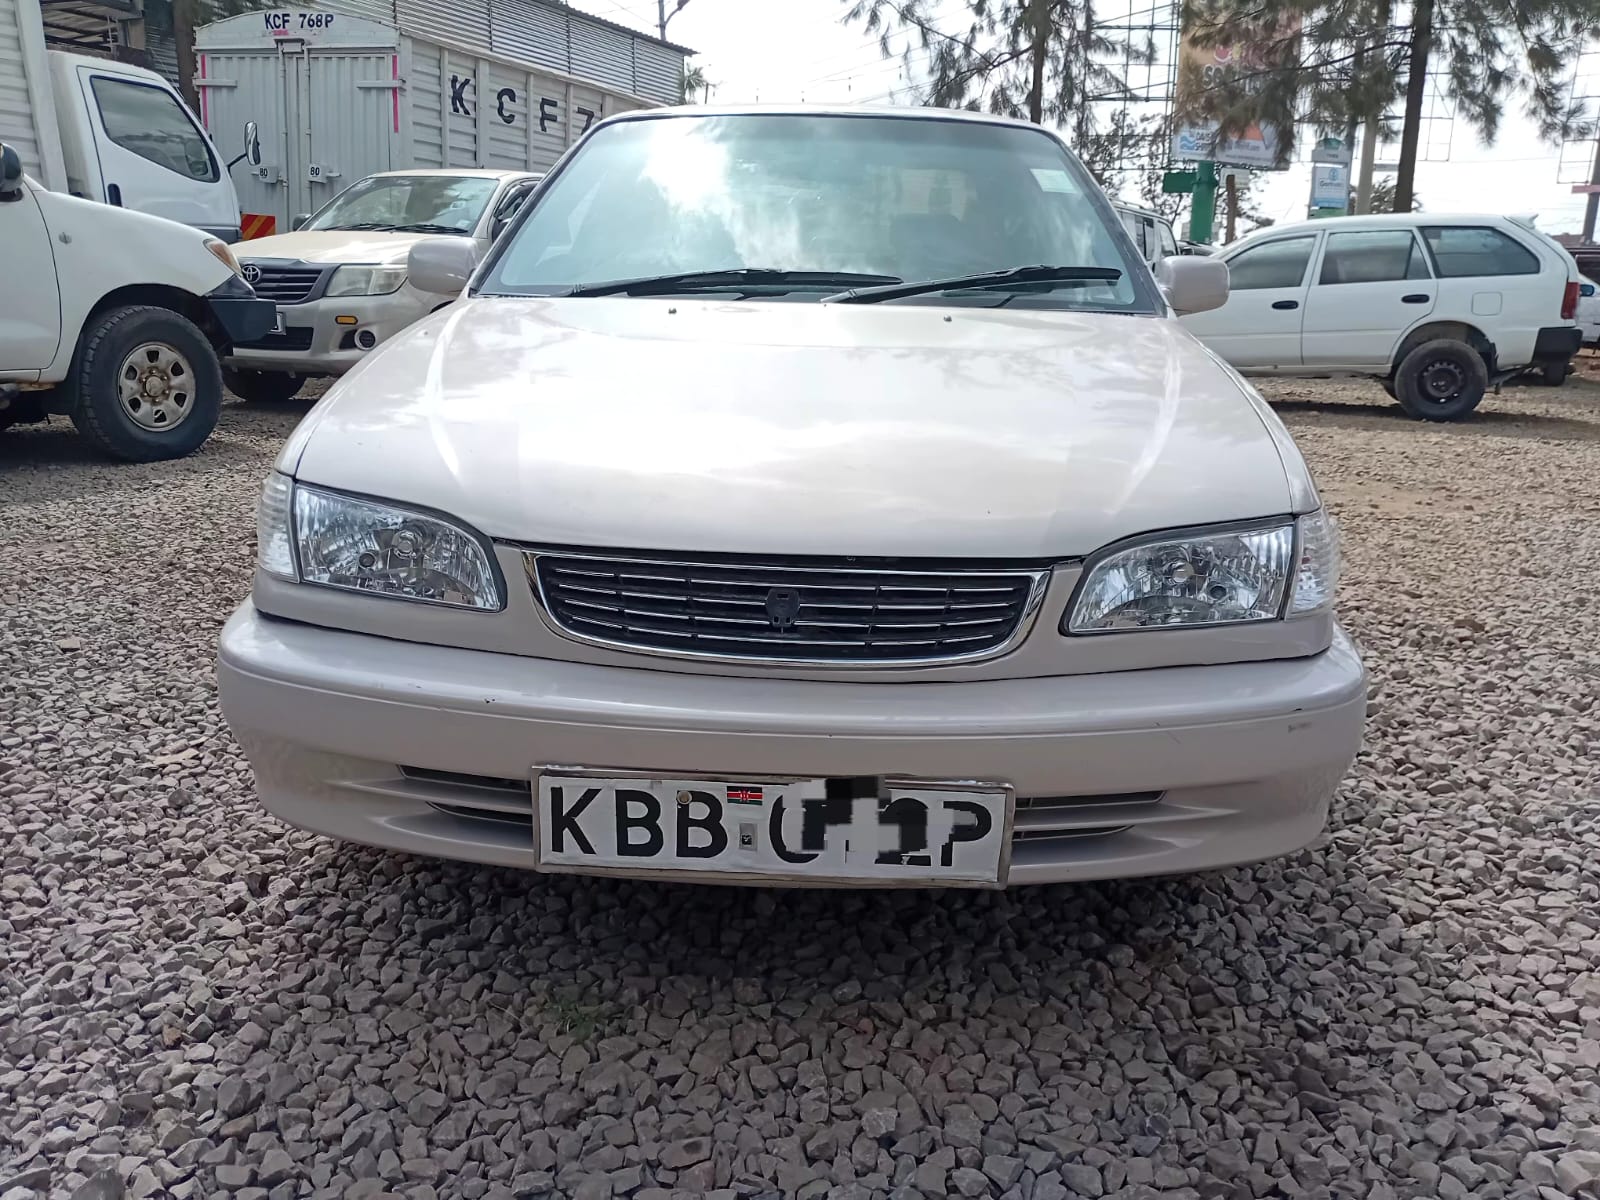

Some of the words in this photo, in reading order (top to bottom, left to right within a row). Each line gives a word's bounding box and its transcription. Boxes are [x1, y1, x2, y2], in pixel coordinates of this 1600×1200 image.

[264, 13, 291, 29] KCF
[298, 13, 334, 29] 768P
[259, 167, 269, 177] 80
[310, 166, 320, 176] 80
[550, 786, 729, 858] KBB
